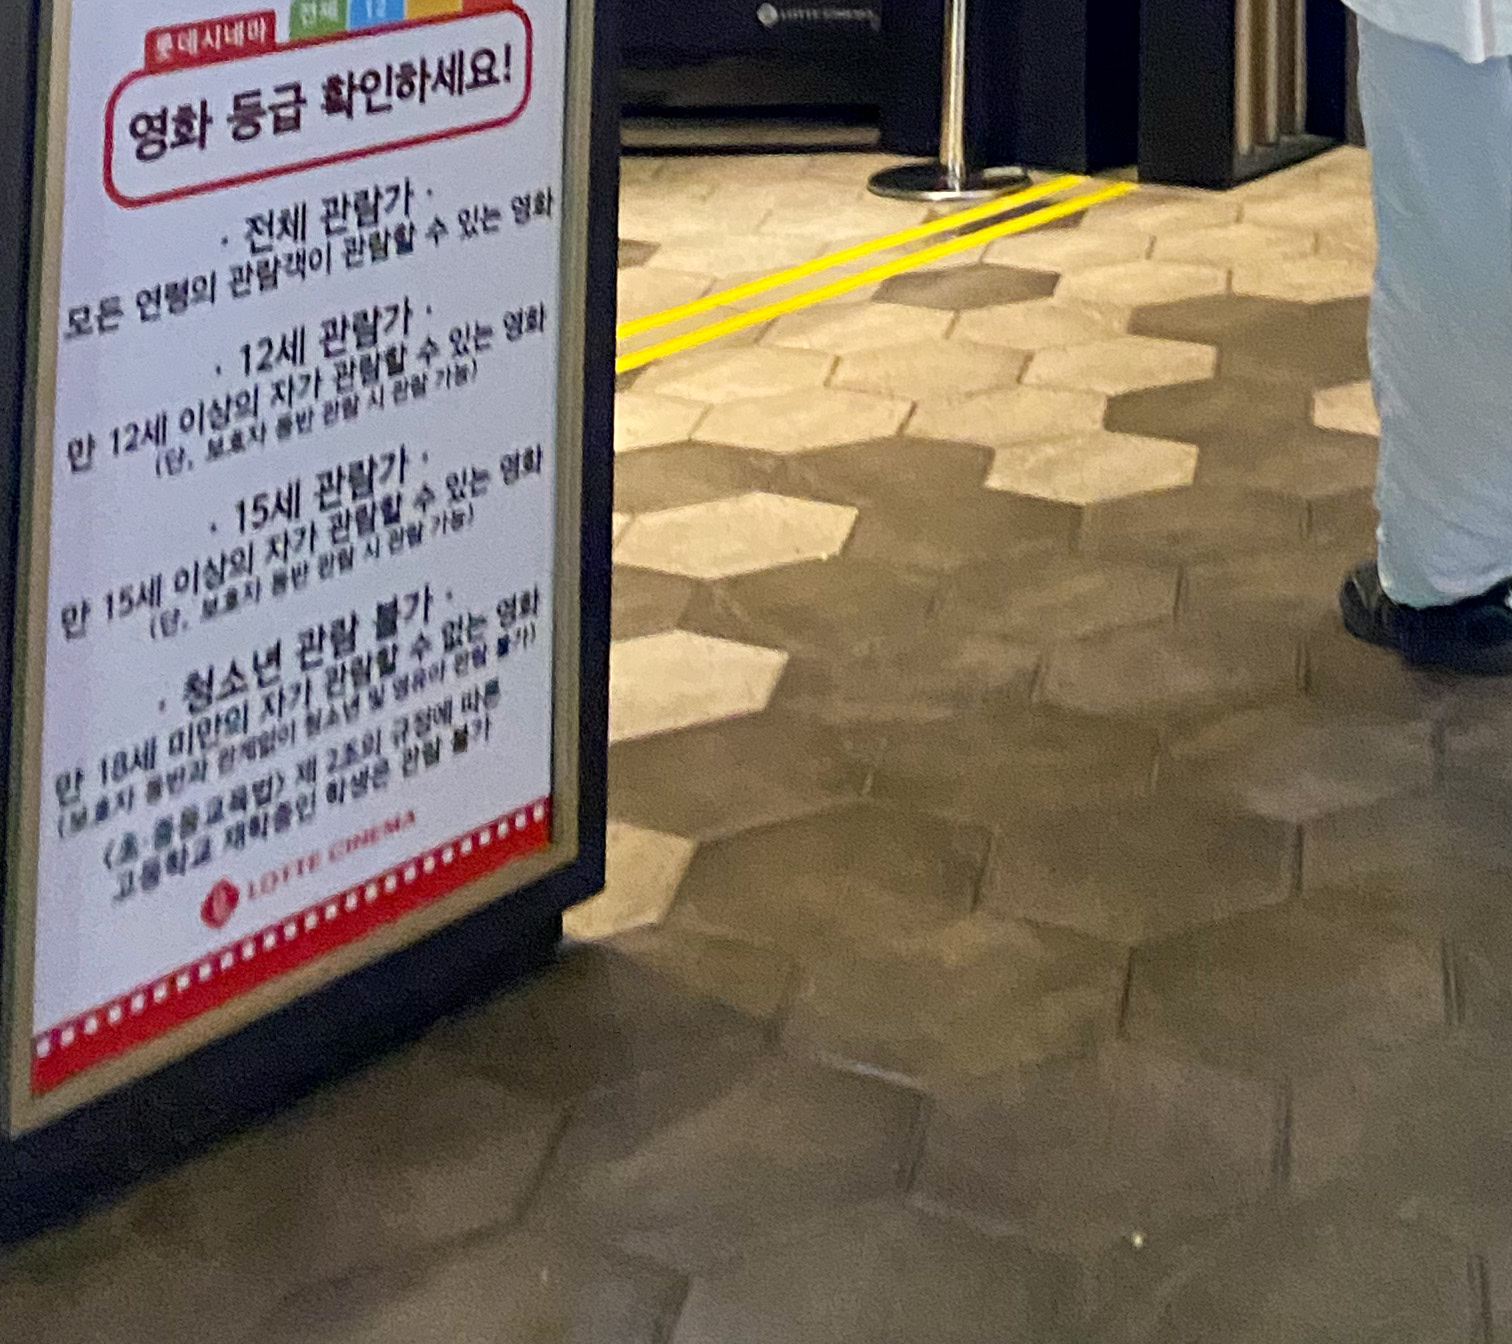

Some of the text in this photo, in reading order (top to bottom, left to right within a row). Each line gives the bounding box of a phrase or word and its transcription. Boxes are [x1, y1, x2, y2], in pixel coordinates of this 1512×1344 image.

[129, 42, 512, 162] 영화 등급 확인하세요!
[64, 184, 554, 341] 모든 연령의 관람객이 관람할 수 있는 영화
[244, 176, 414, 256] 전체 관람가
[67, 300, 546, 475] 만 12세 이상의 자가 관람할 수 있는 영화
[240, 295, 414, 378] 12세 관람가
[61, 442, 544, 642] 만 15세 이상의 자가 관람할 수 있는 영화
[235, 442, 410, 536] 15세 관람가
[182, 580, 433, 716] 청소년 관람 불가
[54, 766, 84, 809] 만
[99, 734, 157, 786] 18세
[410, 628, 432, 664] 수
[248, 809, 416, 901] LOTTE CINEMA
